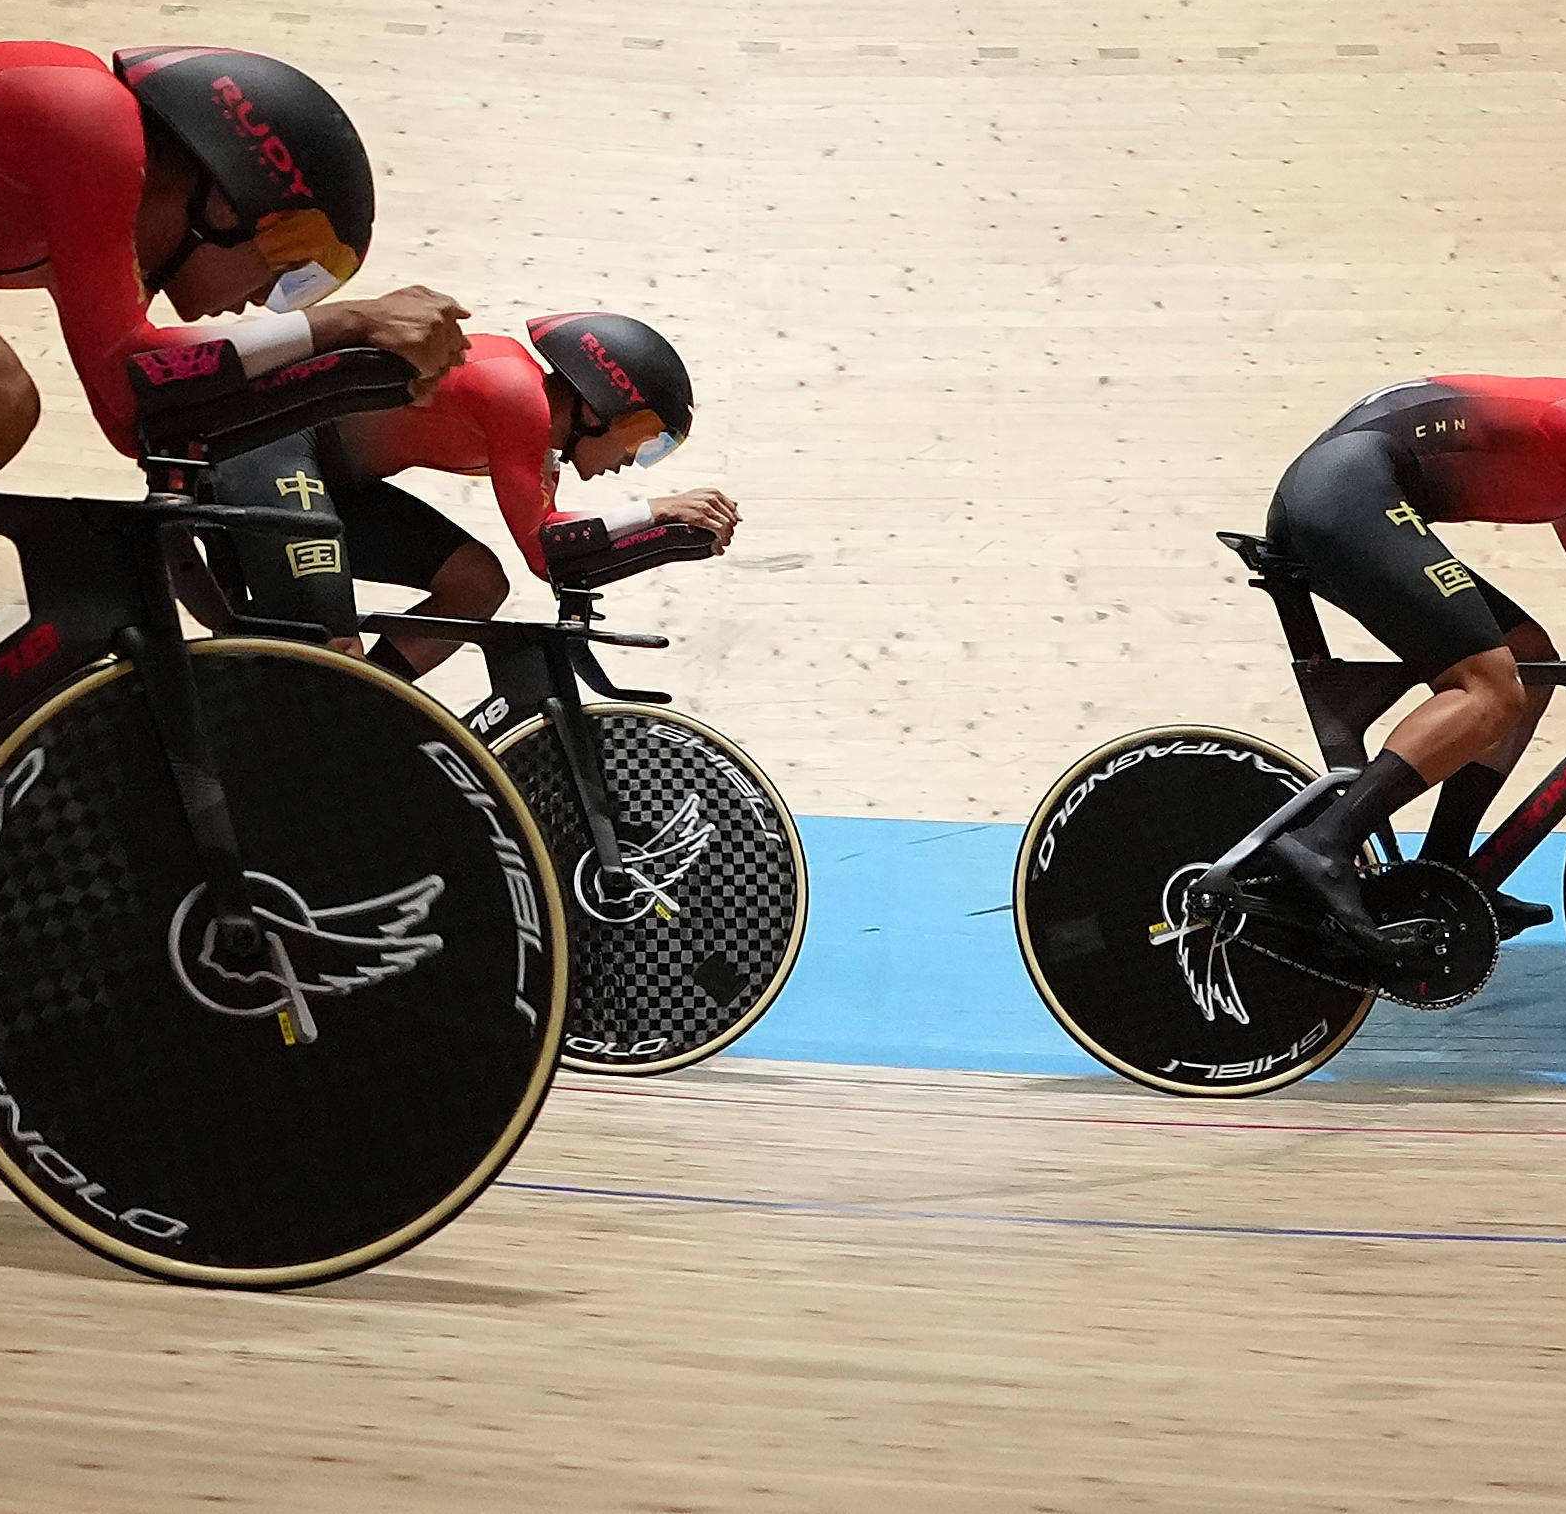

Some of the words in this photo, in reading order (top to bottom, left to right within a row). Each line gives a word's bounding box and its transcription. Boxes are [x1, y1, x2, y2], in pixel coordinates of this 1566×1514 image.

[211, 76, 315, 198] RUDY
[580, 332, 646, 405] RUDY
[1415, 418, 1467, 439] CHN
[468, 696, 510, 734] 18
[650, 724, 784, 849] GHIBLI
[417, 741, 543, 1034] GHIBLI
[1158, 1018, 1328, 1080] GHIBLI
